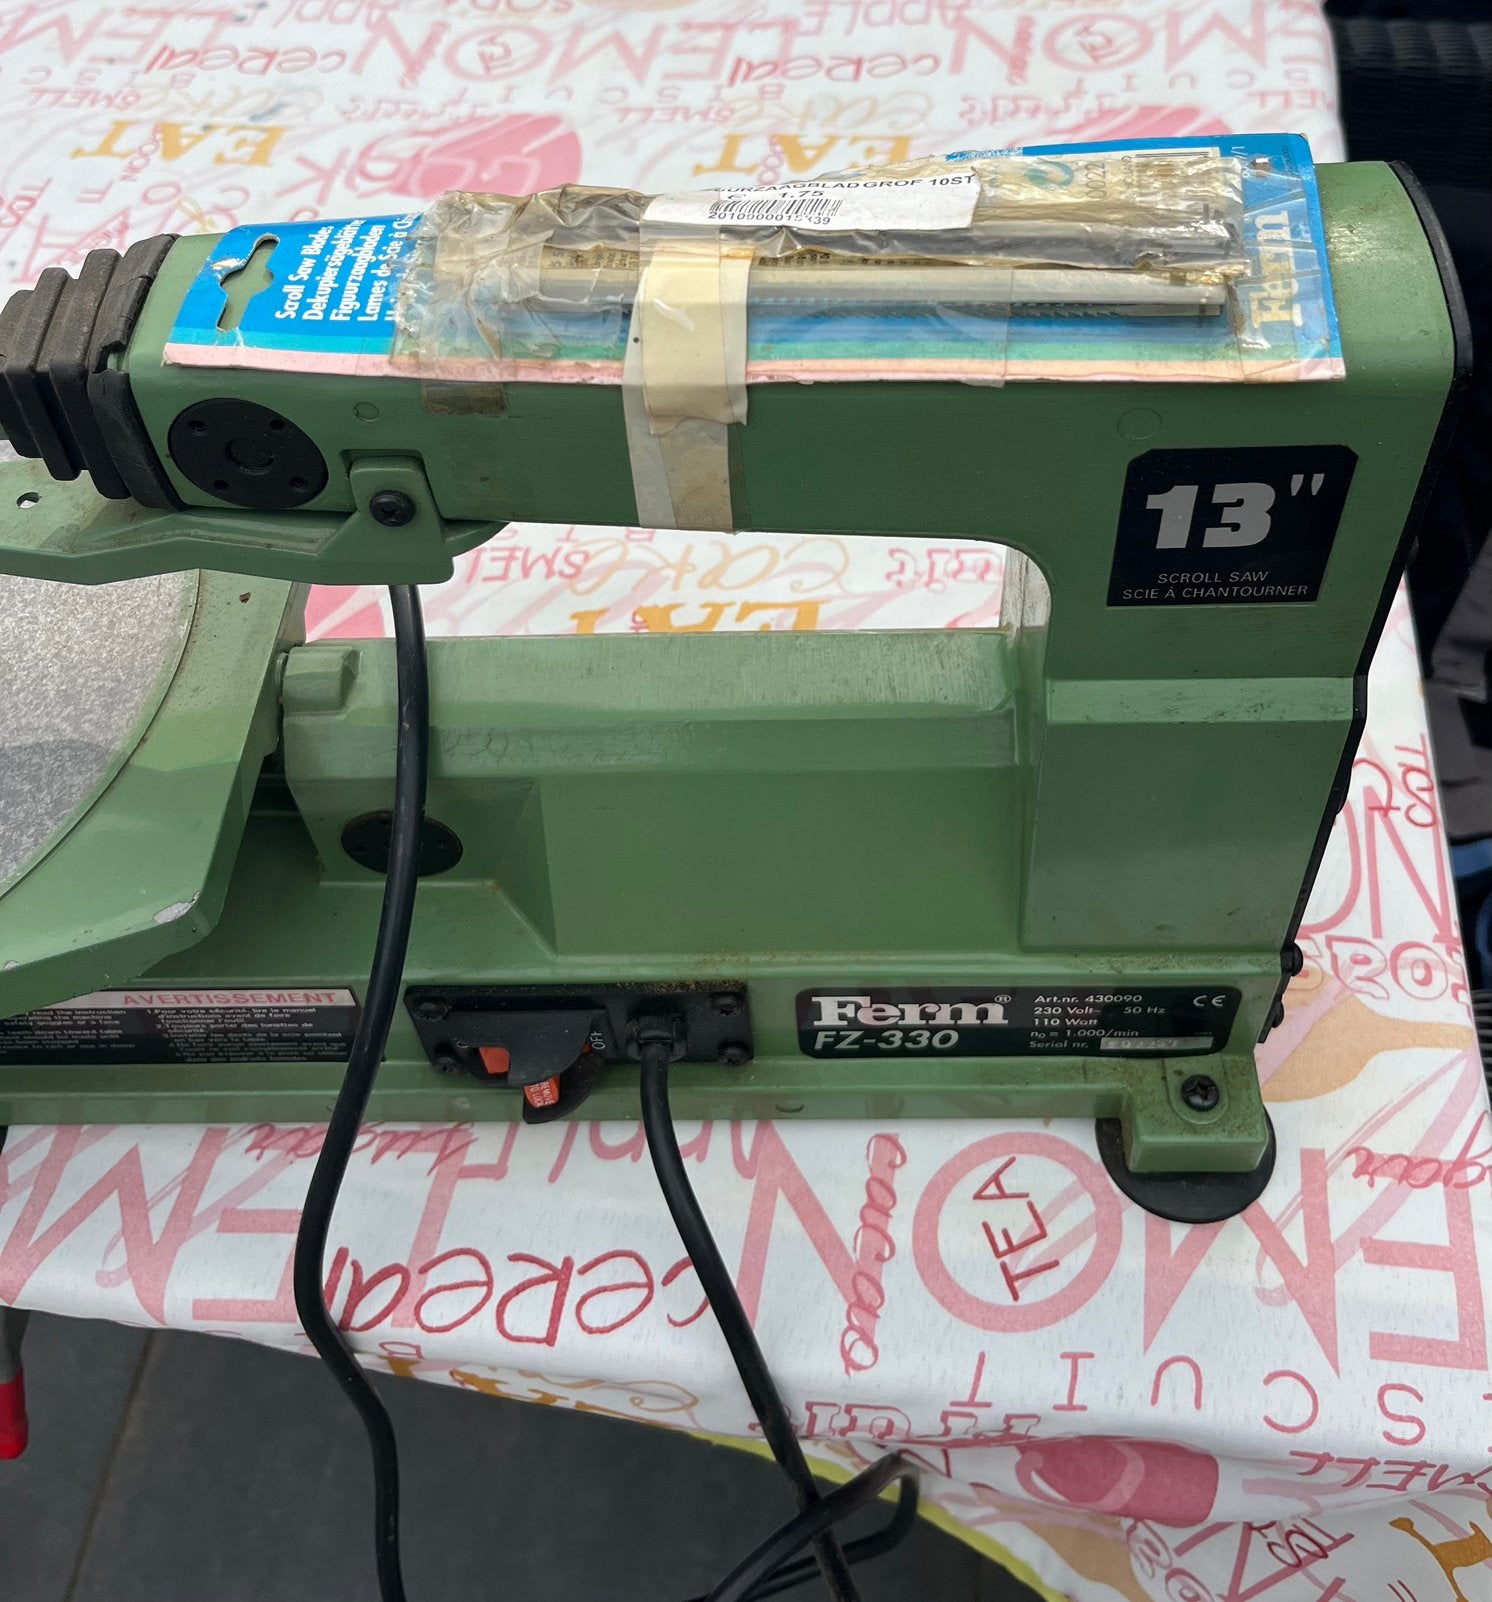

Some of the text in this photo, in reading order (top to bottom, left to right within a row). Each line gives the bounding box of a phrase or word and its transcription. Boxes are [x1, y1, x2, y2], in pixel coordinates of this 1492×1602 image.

[70, 119, 289, 167] EAT
[779, 190, 824, 199] 1.75
[275, 226, 334, 320] Scroll Saw Blades
[330, 225, 386, 321] Figuurzaagbladen
[371, 264, 392, 277] de
[357, 280, 388, 321] Lames
[1158, 571, 1269, 584] SCROLL SAW
[1123, 588, 1159, 600] SCIE
[1182, 585, 1308, 598] CHANTOURNER
[123, 991, 337, 1006] AVERTISSEMENT
[1034, 994, 1142, 1003] Art.nr. 430090
[1033, 1006, 1061, 1015] 230
[1124, 1006, 1142, 1014] 50
[1147, 1006, 1166, 1014] Hz
[1033, 1017, 1098, 1026] 110 Watt
[814, 1030, 959, 1050] FZ-330
[1065, 1028, 1139, 1038] 1.000/min
[1030, 1040, 1068, 1049] Serial
[971, 1154, 1061, 1303] TEA
